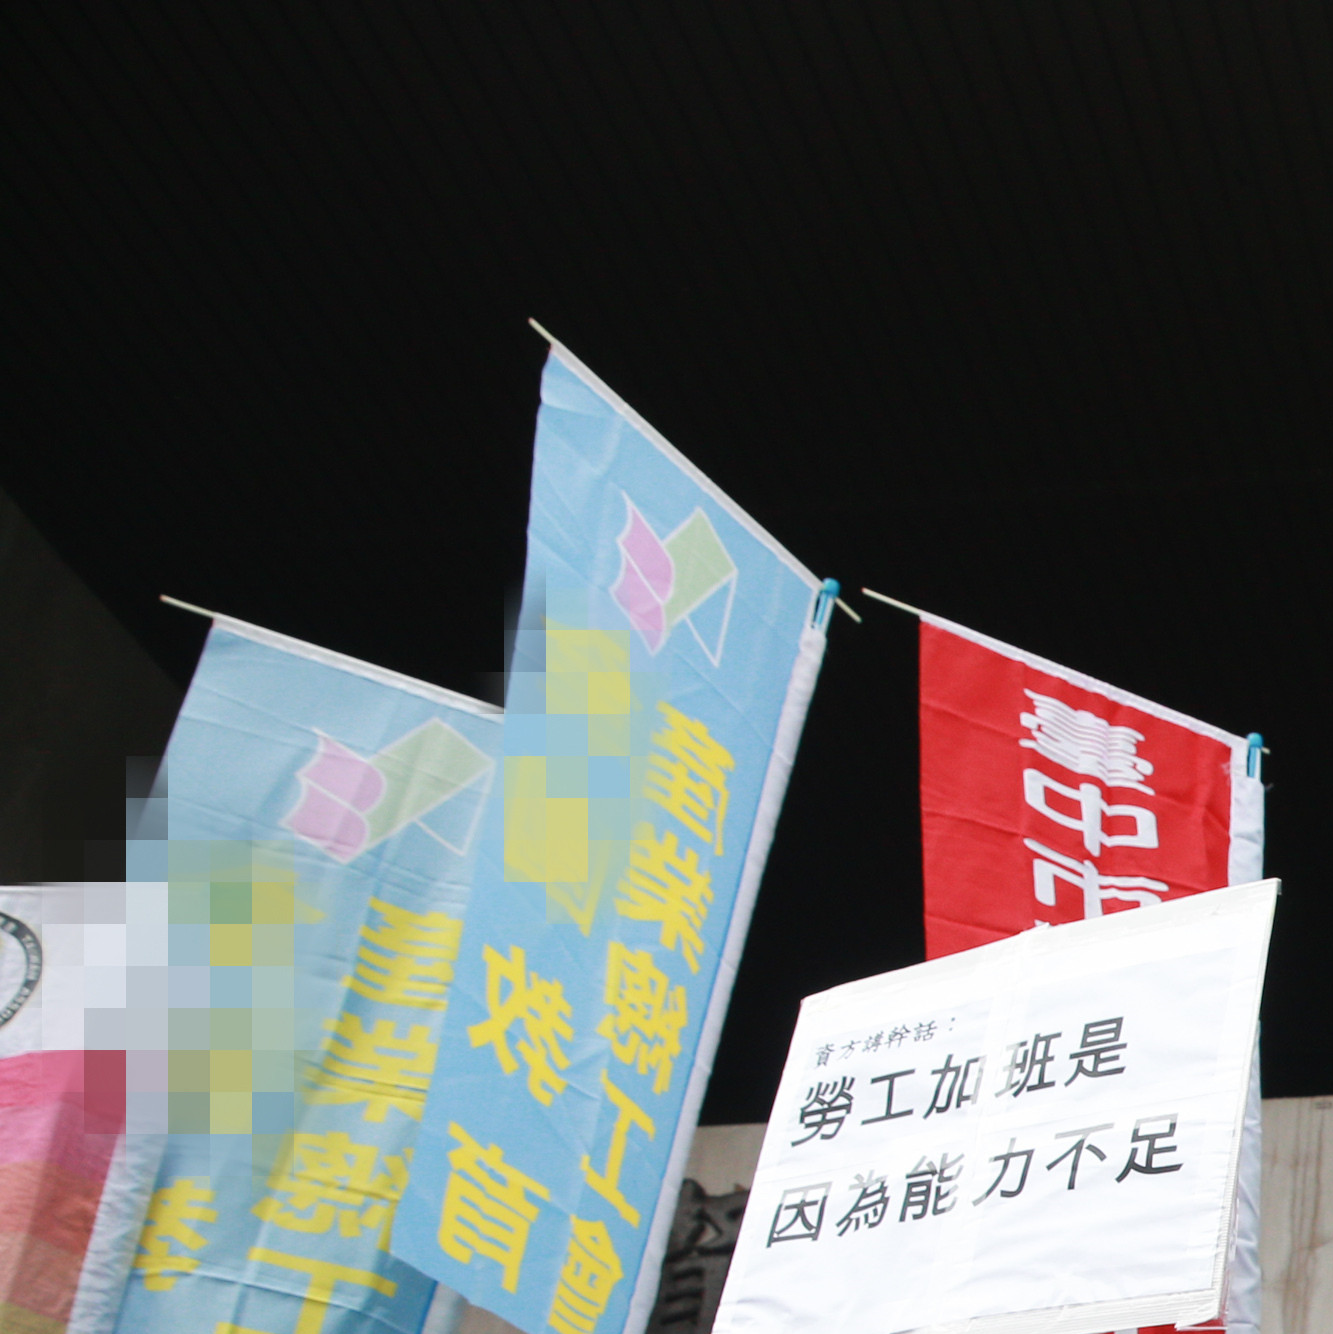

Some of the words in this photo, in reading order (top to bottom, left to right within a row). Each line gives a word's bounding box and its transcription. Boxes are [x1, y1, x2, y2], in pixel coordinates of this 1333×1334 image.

[791, 1017, 1129, 1147] 勞工加班是
[766, 1113, 1184, 1249] 因為能力不足
